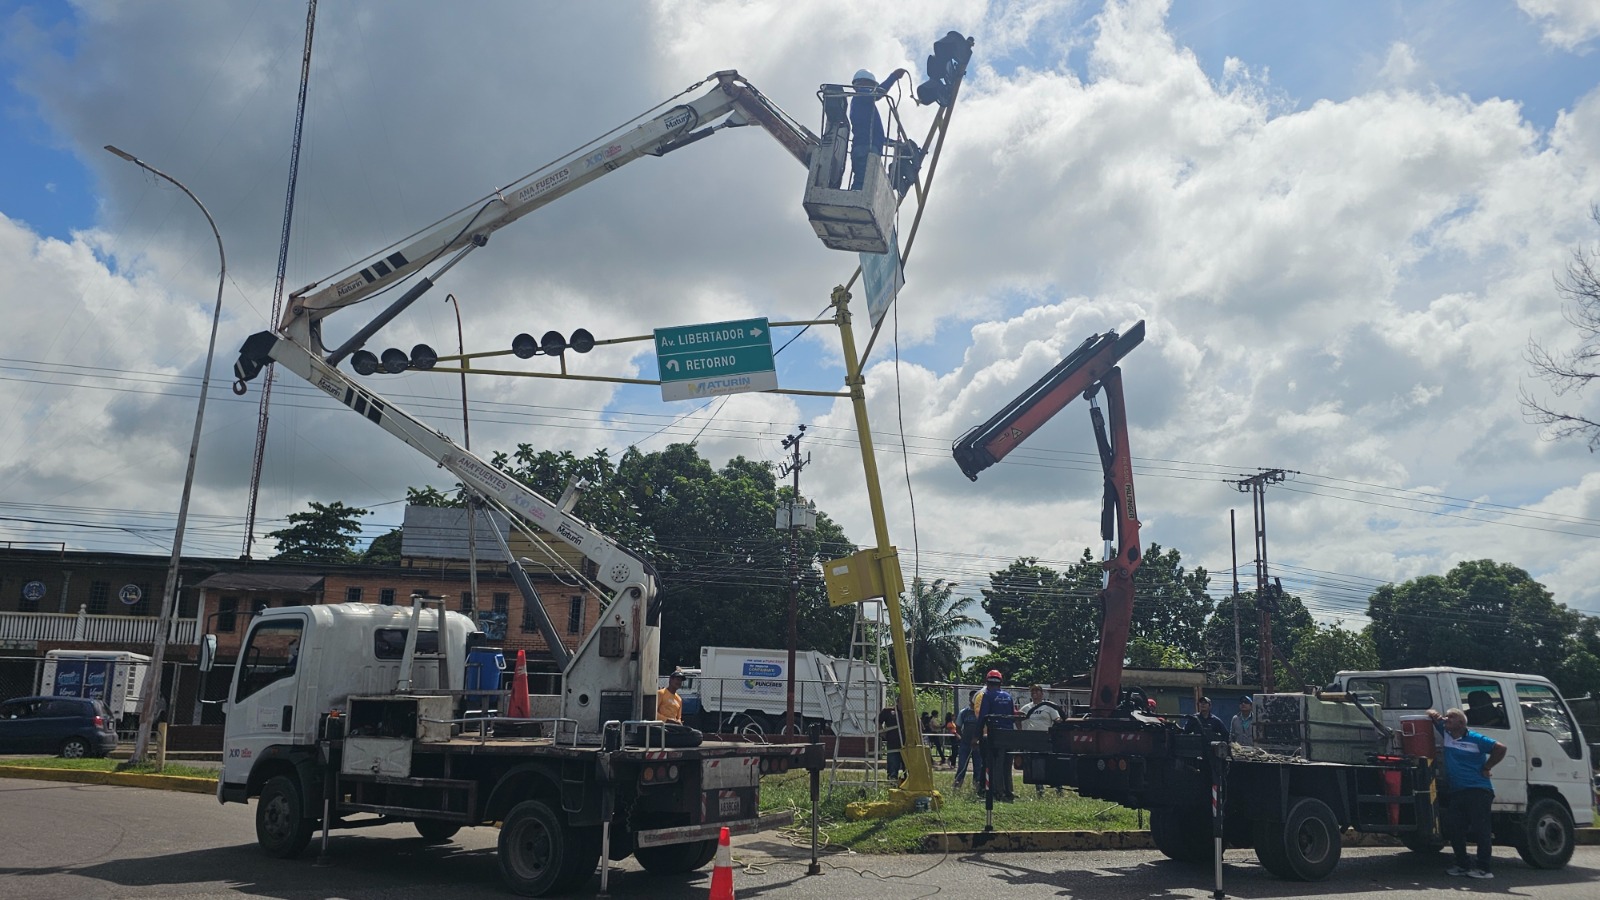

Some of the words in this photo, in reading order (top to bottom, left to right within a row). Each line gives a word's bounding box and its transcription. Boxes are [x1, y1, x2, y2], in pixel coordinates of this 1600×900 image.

[518, 187, 535, 199] ANA
[534, 168, 570, 189] FUENTES
[661, 336, 676, 348] Av.
[678, 328, 745, 346] LIBERTADOR
[685, 355, 736, 371] RETORNO
[687, 376, 751, 396] MATURÍN
[458, 456, 475, 470] ANA
[475, 466, 508, 490] FUENTES
